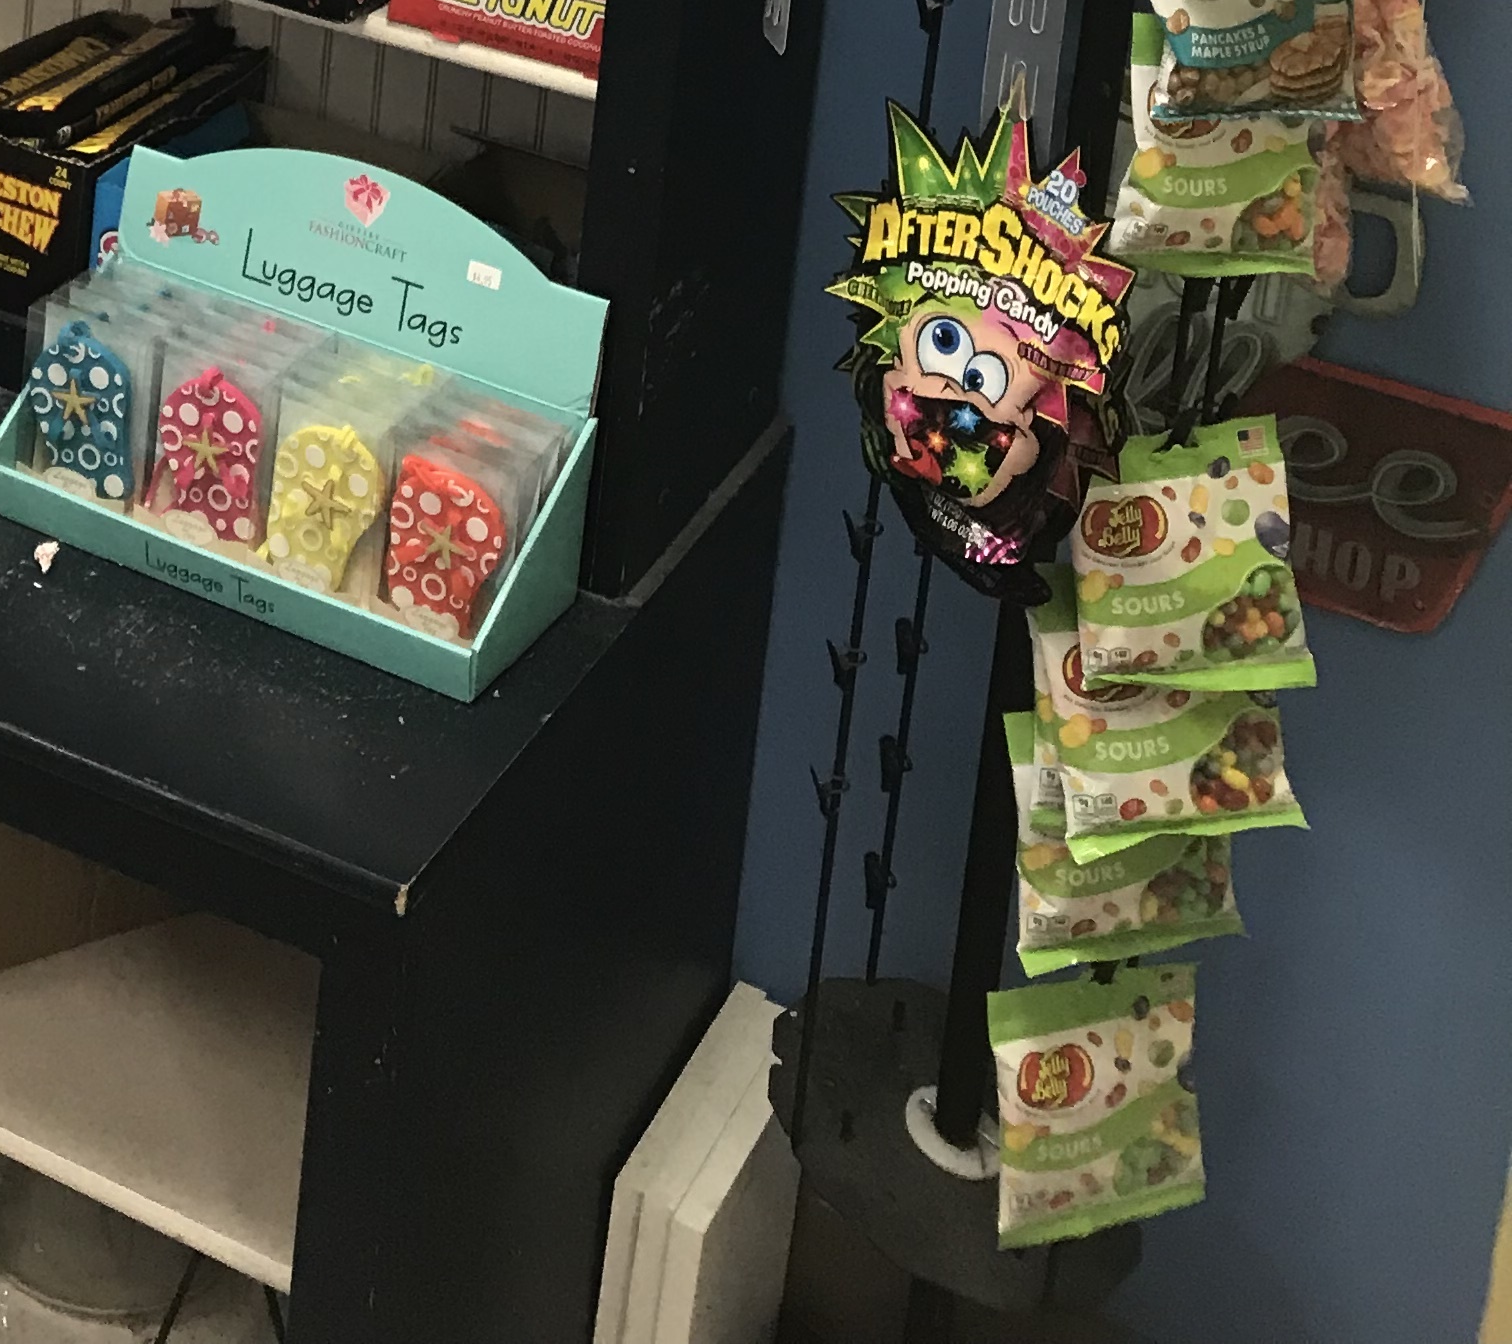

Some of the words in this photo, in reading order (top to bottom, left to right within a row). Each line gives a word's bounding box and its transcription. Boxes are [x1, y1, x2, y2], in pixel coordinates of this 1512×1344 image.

[1191, 43, 1233, 59] MAPLE
[1233, 34, 1271, 56] SYRUP
[53, 165, 70, 180] 24
[1044, 168, 1079, 205] 20
[1161, 174, 1228, 197] SOURS
[308, 219, 408, 263] FASHIONCRAFT
[241, 227, 376, 318] Luggage
[391, 276, 464, 348] Tags
[905, 261, 993, 308] Popping
[995, 282, 1061, 344] Candy
[145, 540, 225, 598] Luggage
[231, 574, 277, 616] Tags
[1296, 521, 1422, 603] HOP
[1110, 590, 1186, 617] SOURS
[1094, 735, 1171, 763] SOURS
[1054, 860, 1126, 888] SOURS
